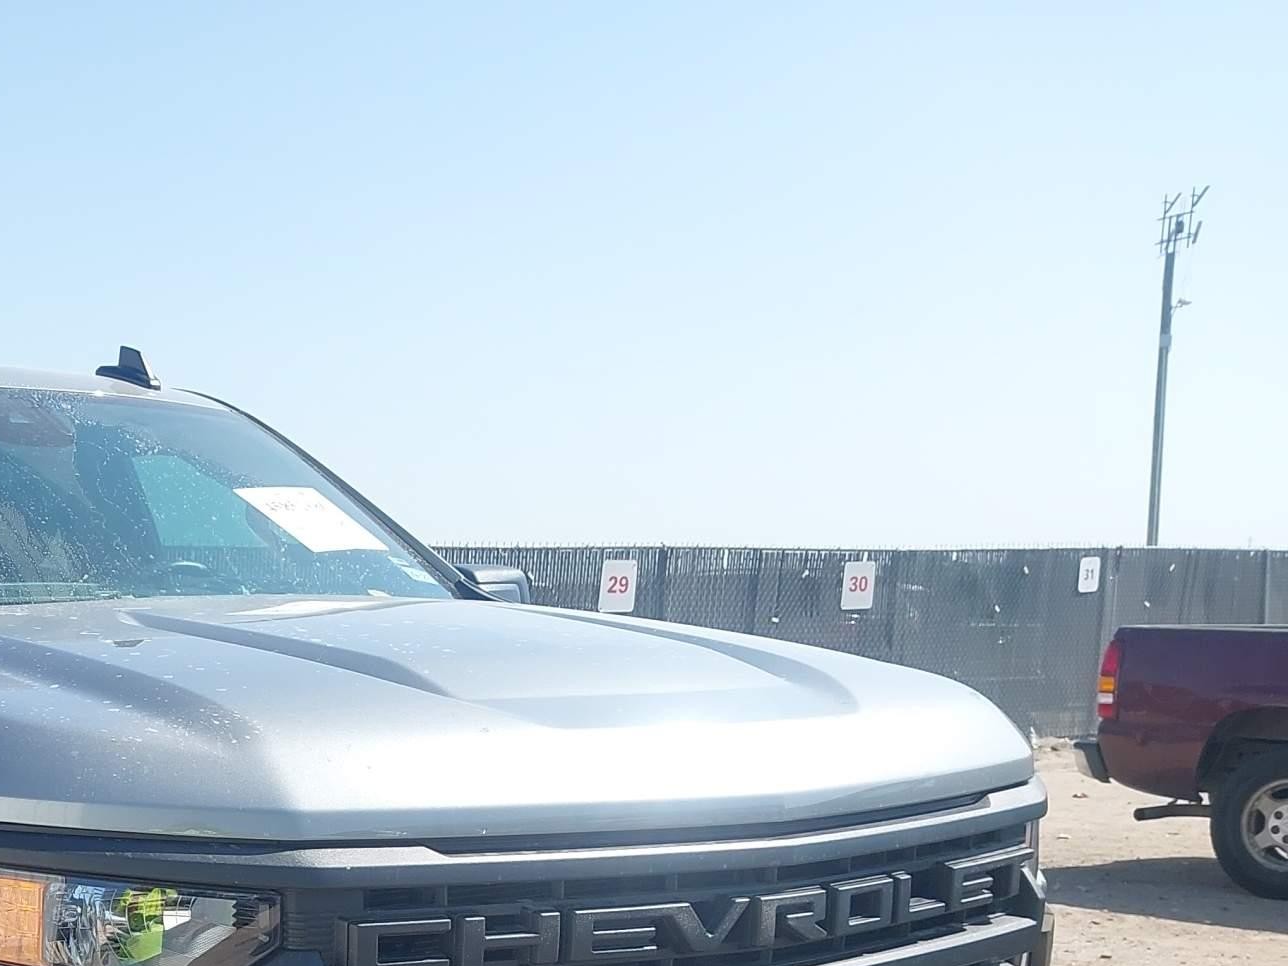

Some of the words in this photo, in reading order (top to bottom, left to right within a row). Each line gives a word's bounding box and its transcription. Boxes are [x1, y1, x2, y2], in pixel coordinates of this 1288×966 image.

[1083, 569, 1094, 581] 31
[607, 576, 629, 594] 29
[849, 576, 868, 592] 30
